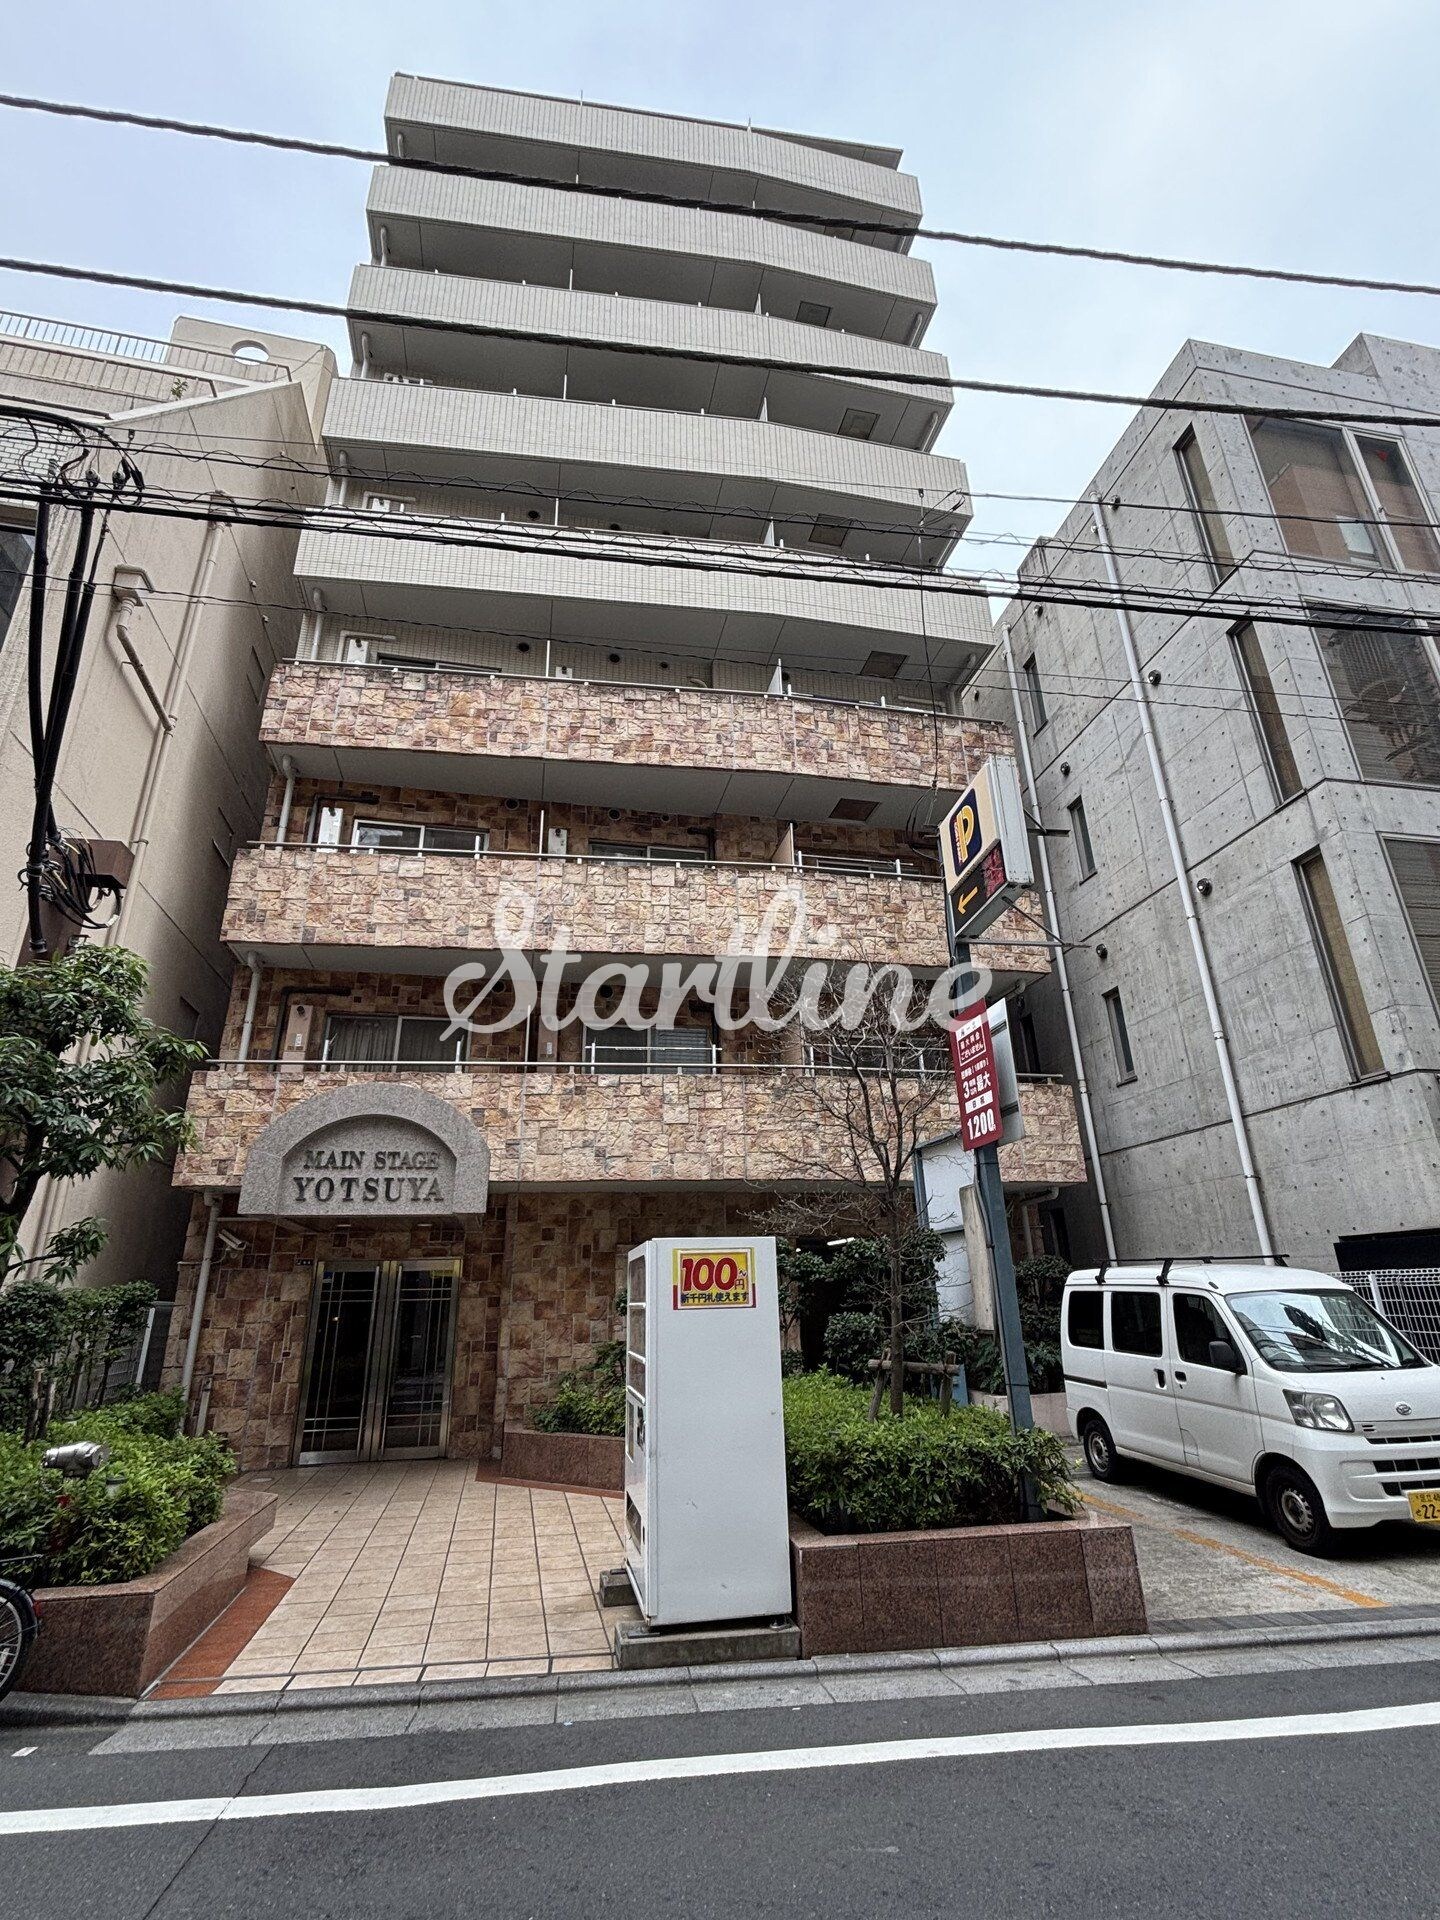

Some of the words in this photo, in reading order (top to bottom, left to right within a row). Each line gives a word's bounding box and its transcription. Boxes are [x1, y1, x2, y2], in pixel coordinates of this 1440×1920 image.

[956, 805, 974, 863] P
[303, 1150, 365, 1170] MAIN
[374, 1150, 442, 1170] STAGE
[293, 1176, 445, 1202] YOTSUYA
